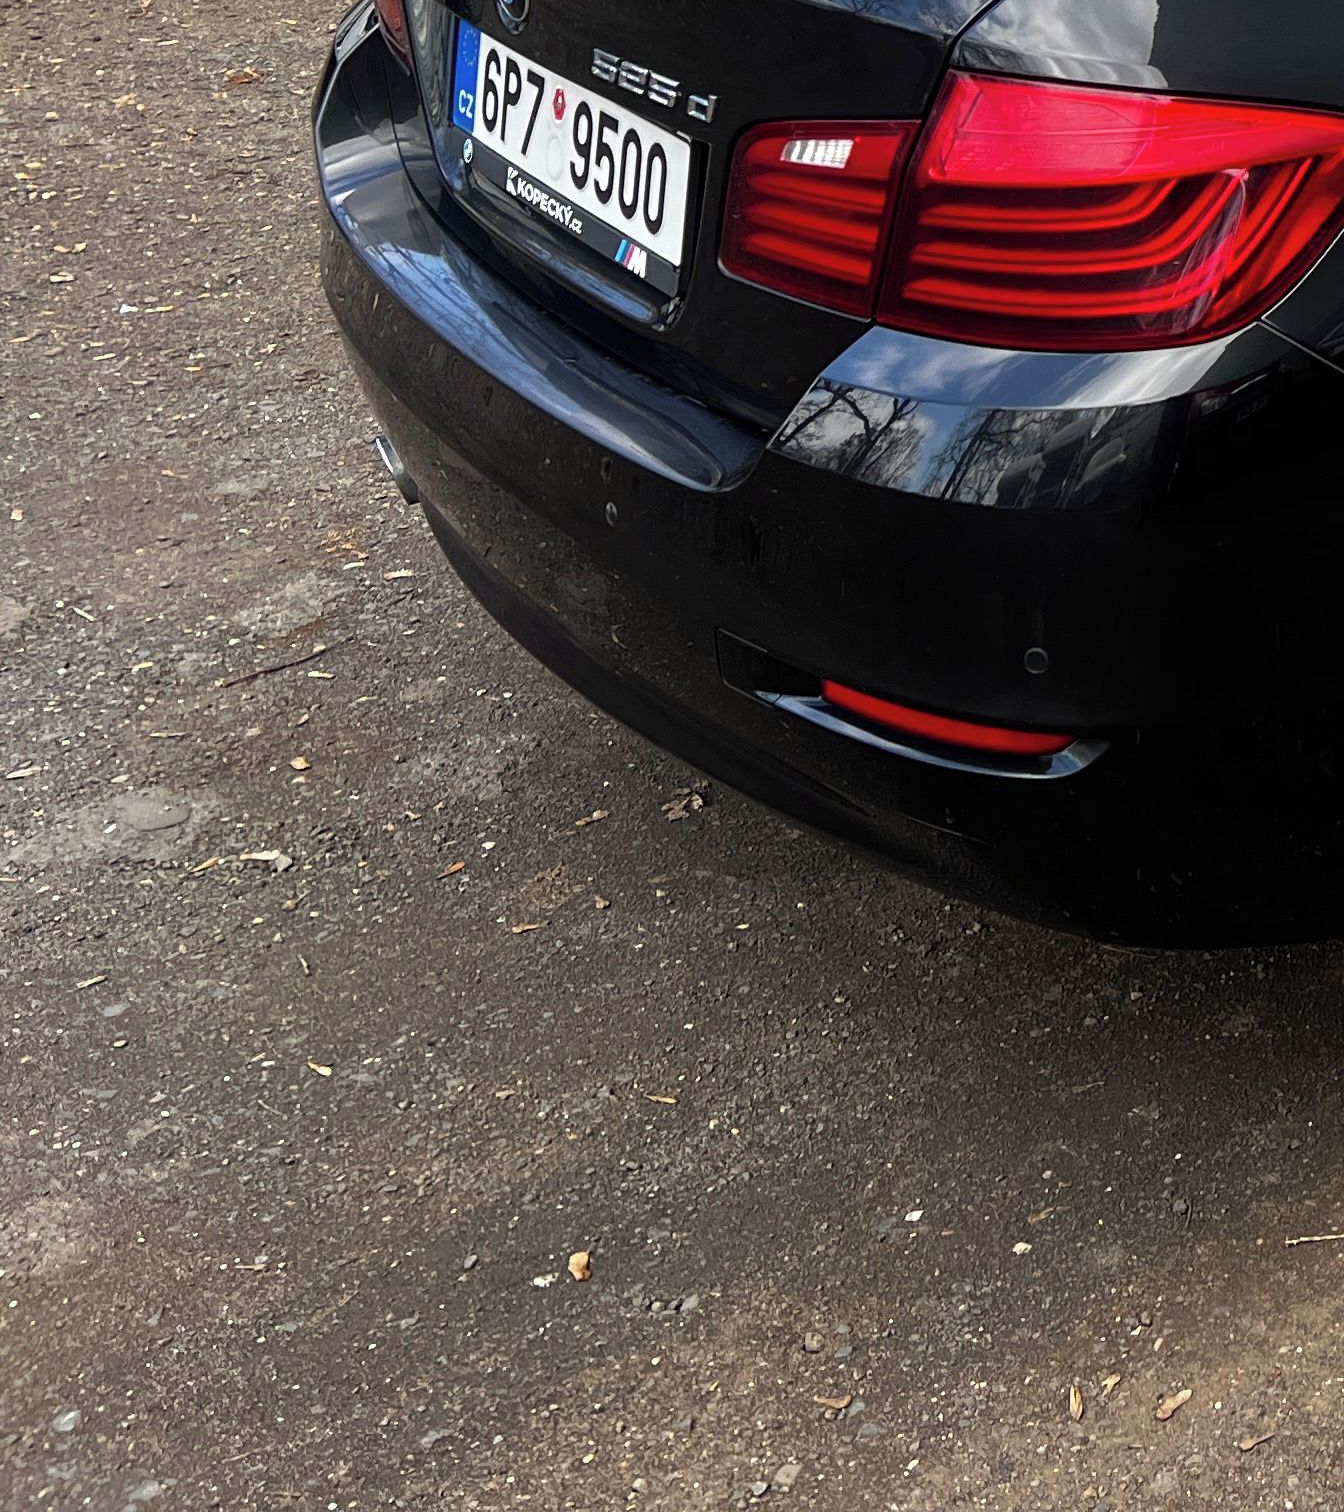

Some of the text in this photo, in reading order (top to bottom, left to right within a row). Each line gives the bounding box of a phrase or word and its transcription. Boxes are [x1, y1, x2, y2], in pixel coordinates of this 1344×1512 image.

[458, 89, 474, 119] CZ
[591, 48, 681, 108] 525
[482, 48, 667, 235] 6P7 9500
